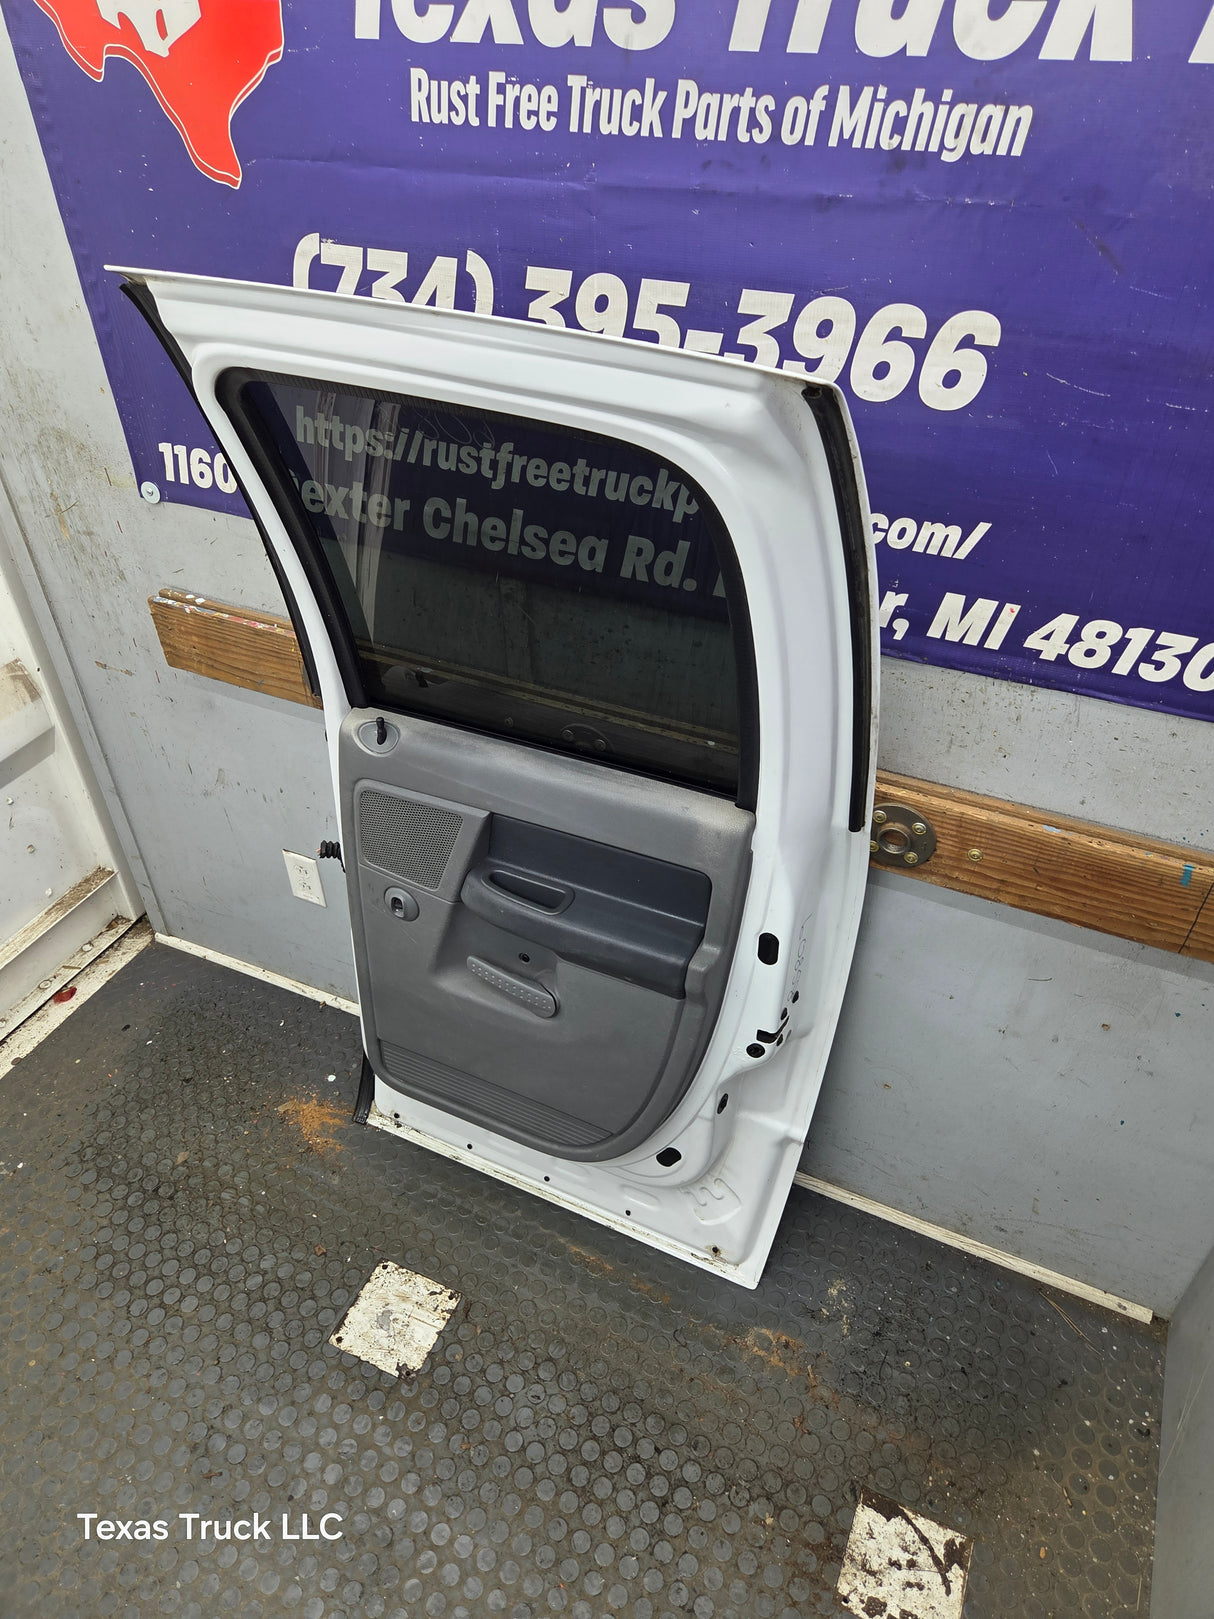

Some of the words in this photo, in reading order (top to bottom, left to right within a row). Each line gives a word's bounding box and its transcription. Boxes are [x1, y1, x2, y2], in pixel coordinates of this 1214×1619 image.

[410, 67, 480, 127] Rust
[488, 71, 558, 131] Free
[567, 75, 668, 138] Truck
[671, 79, 775, 144] Parts
[780, 85, 828, 146] of
[828, 85, 1034, 163] Michigan
[292, 232, 494, 315] (734)
[525, 266, 1001, 411] 395-3966
[289, 468, 411, 531] exter
[422, 497, 609, 573] Chelsea
[619, 535, 698, 592] Rd.
[926, 592, 1021, 650] MI
[1023, 613, 1214, 692] 48130
